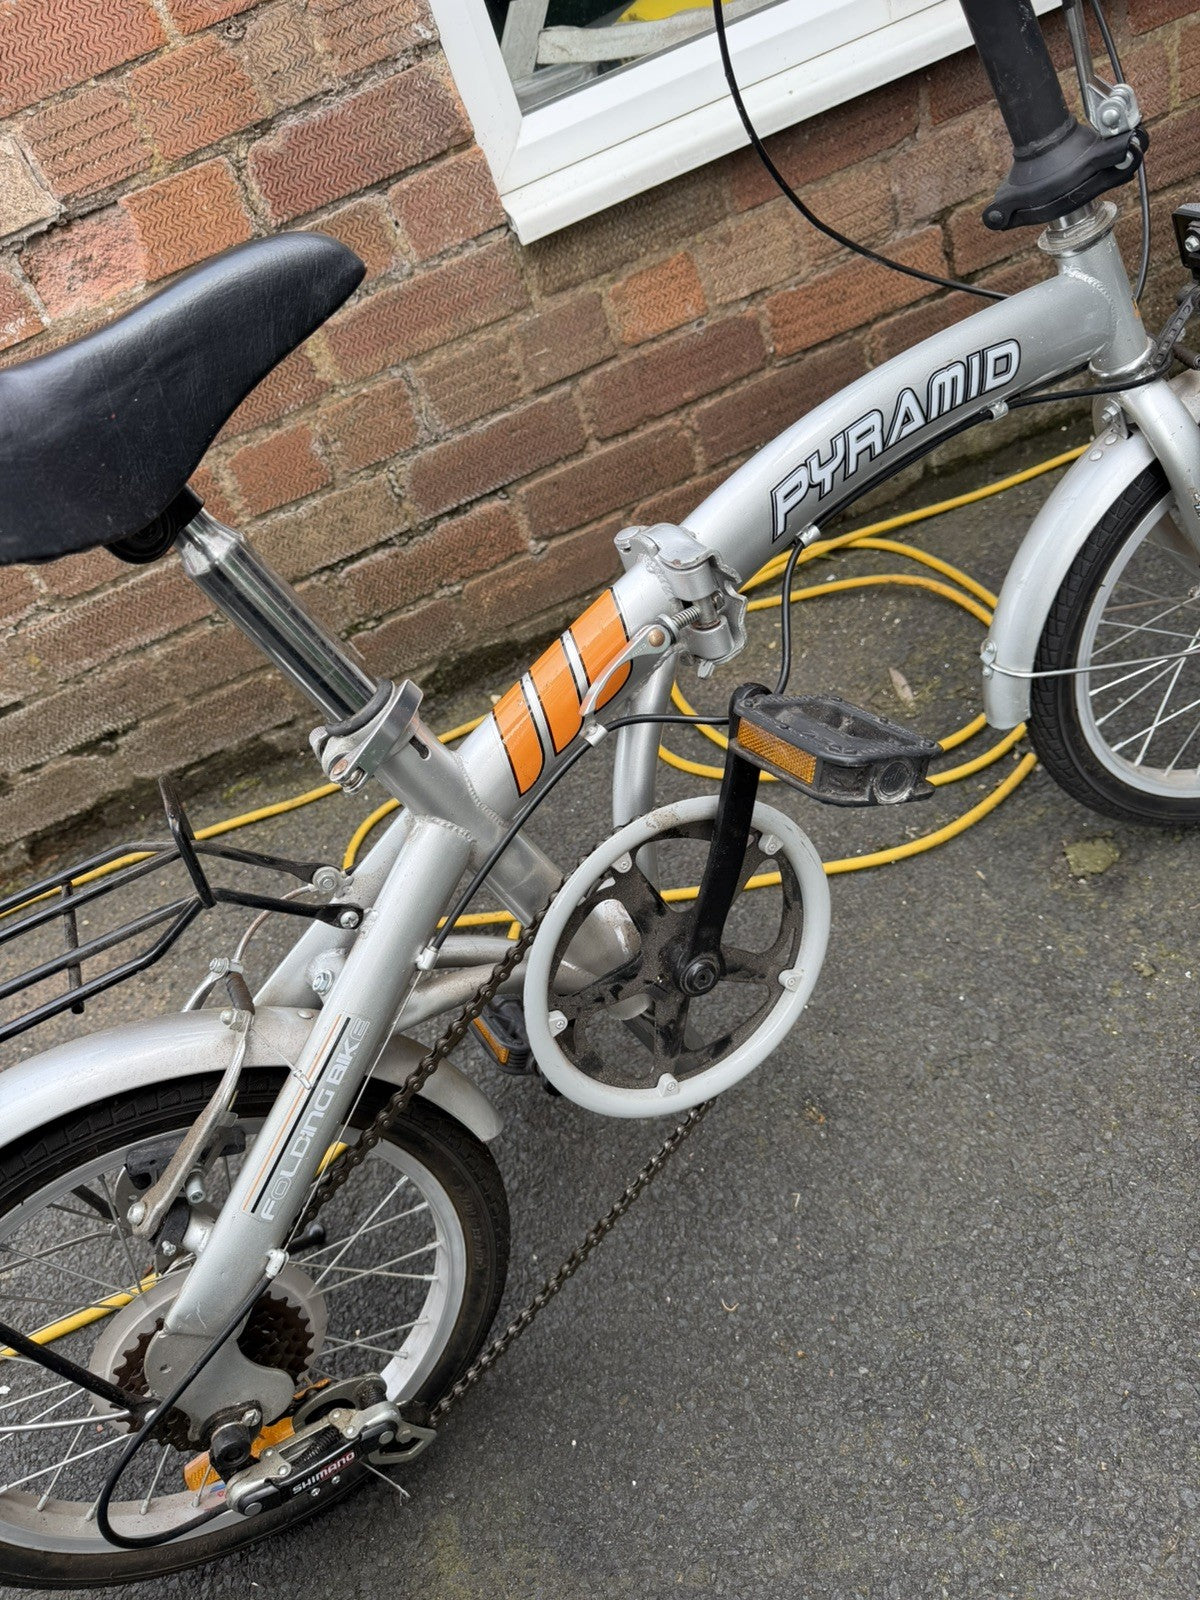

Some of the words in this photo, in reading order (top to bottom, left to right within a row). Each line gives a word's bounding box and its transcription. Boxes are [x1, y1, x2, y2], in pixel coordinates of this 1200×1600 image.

[771, 338, 1021, 544] PYRAMID
[260, 1088, 335, 1222] FOLDING
[327, 1017, 370, 1086] BIKE
[292, 1451, 355, 1494] SHIMANO
